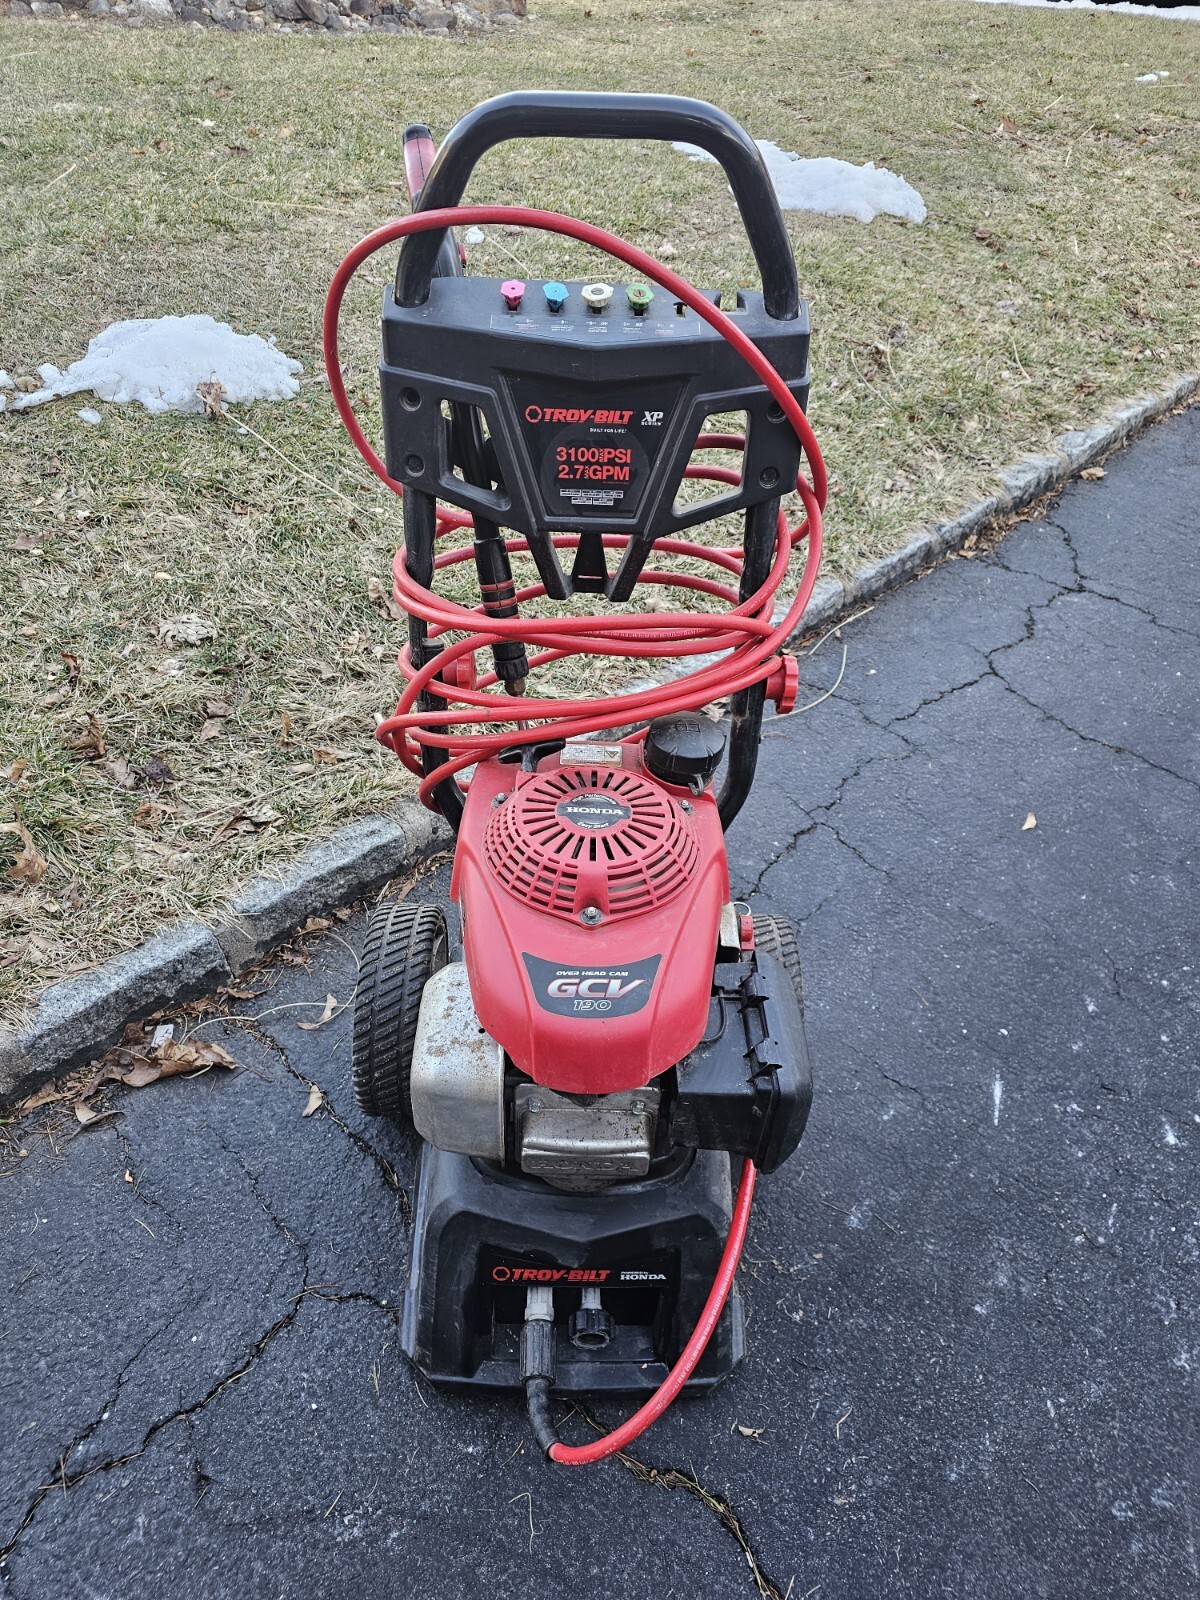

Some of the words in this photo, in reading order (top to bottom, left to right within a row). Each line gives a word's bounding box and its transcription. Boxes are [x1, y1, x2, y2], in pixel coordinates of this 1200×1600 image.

[543, 408, 633, 424] TROY-BILT
[641, 411, 664, 422] XP
[556, 446, 599, 462] 3100
[604, 448, 632, 463] PSI
[558, 465, 584, 479] 2.7
[589, 466, 630, 481] GPM
[566, 806, 624, 815] HONDA
[547, 978, 646, 998] GCV
[574, 1000, 612, 1011] 190
[511, 1268, 612, 1282] TROY-BILT
